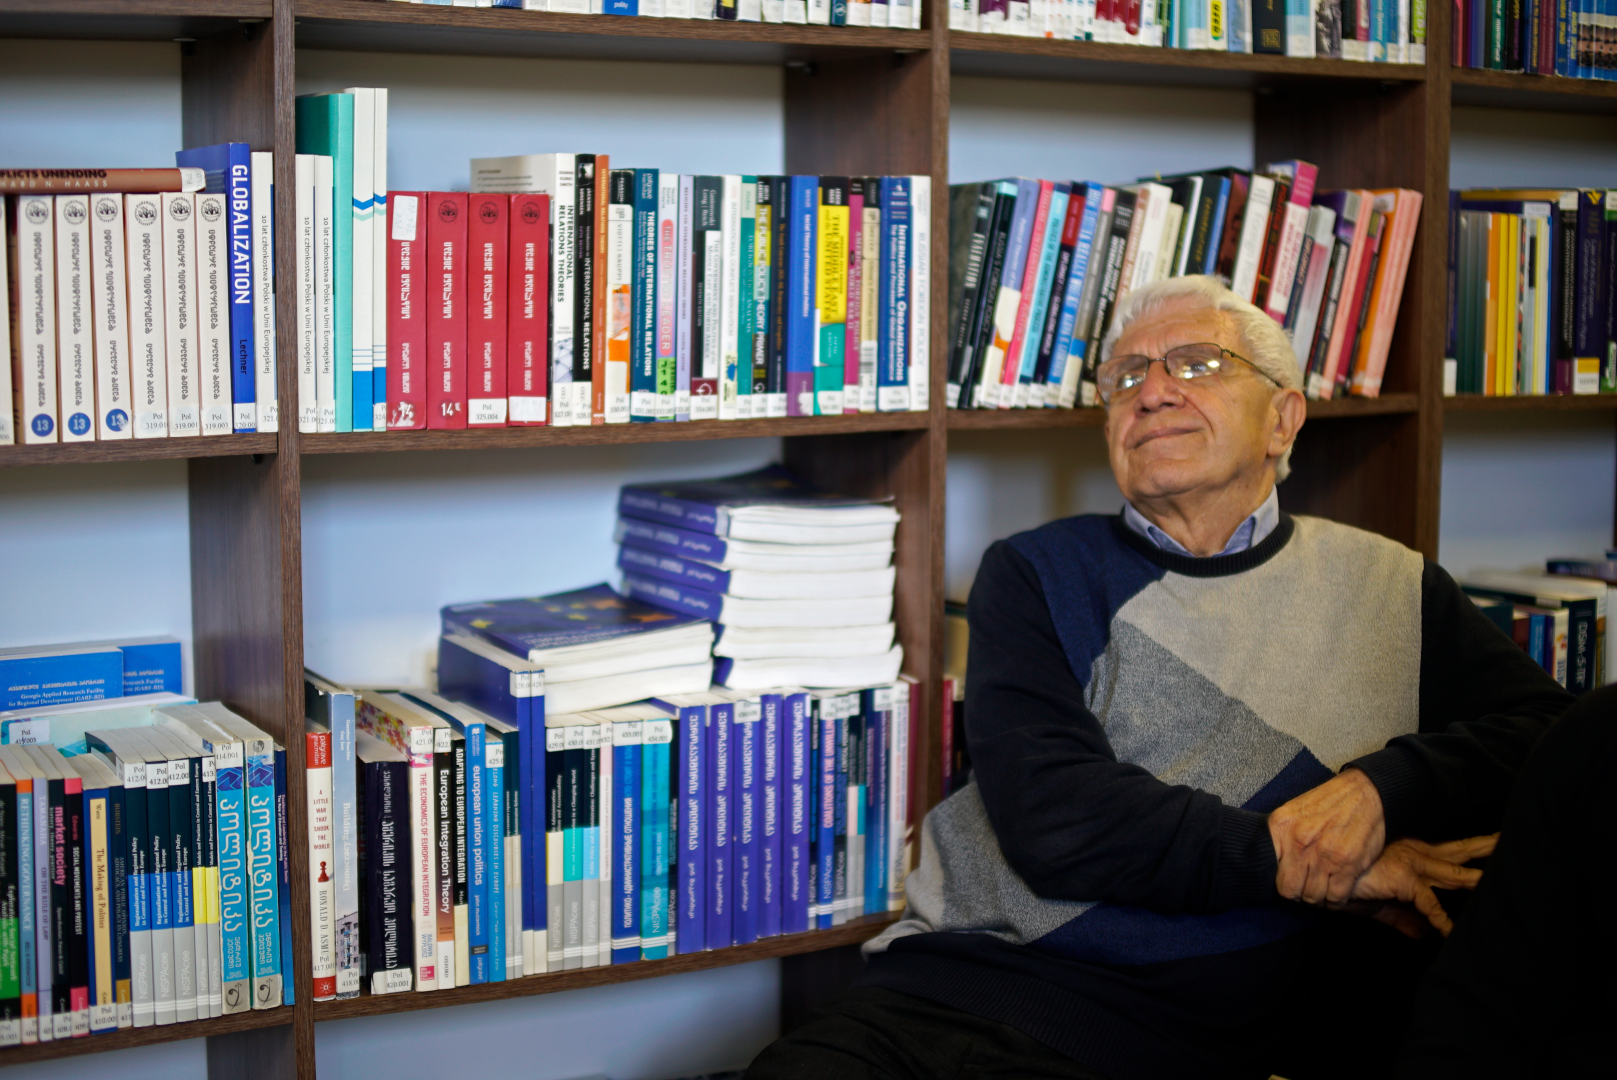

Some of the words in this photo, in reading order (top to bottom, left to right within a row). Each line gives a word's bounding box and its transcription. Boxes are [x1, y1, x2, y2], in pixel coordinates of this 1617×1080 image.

[614, 2, 628, 10] polity
[232, 164, 249, 304] GLOBALIZATION
[647, 211, 655, 250] THEORIES
[759, 208, 768, 224] THE
[832, 215, 840, 239] THE
[142, 233, 150, 272] პროექტი
[208, 229, 216, 268] პროექტი
[401, 242, 410, 270] მიწები
[443, 242, 452, 270] მიწები
[646, 252, 653, 263] OF
[758, 226, 767, 258] PUBLIC
[897, 225, 908, 297] INTERNATIONAL
[917, 232, 926, 275] RUSSIAN
[662, 244, 672, 299] TRUSTED
[757, 261, 766, 297] POLICY
[831, 240, 839, 286] MIDDLE
[1331, 244, 1348, 300] INTERNATIONAL
[144, 276, 152, 334] დემოკრატიის
[210, 271, 218, 330] დემოკრატიის
[401, 274, 410, 319] სისხლიანი
[443, 273, 452, 319] სისხლიანი
[645, 265, 653, 329] INTERNATIONAL
[756, 298, 766, 329] THEORY
[802, 296, 810, 317] Politics
[830, 289, 838, 315] EAST
[917, 279, 926, 323] FOREIGN
[662, 302, 672, 349] LEADER
[1093, 298, 1107, 338] RELATIONS
[1322, 302, 1338, 339] SECURITY
[239, 339, 247, 375] Lechner
[755, 331, 765, 364] PRIMER
[896, 301, 907, 380] ORGANIZATIONS
[917, 328, 926, 366] POLICY
[1088, 340, 1099, 370] THEORY
[36, 420, 48, 432] 13
[175, 421, 198, 430] 319.001
[205, 422, 229, 430] 319.003
[442, 403, 454, 416] 14
[456, 748, 464, 784] ADAPTING
[689, 715, 699, 794] ევროკავშირის
[717, 712, 727, 790] ევროკავშირის
[824, 758, 834, 771] THE
[440, 769, 450, 818] European
[456, 786, 464, 795] TO
[472, 766, 483, 814] european
[824, 774, 834, 783] OF
[55, 807, 65, 844] market
[343, 802, 351, 840] Building
[420, 788, 428, 826] ECONOMICS
[456, 796, 465, 834] EUROPEAN
[689, 799, 699, 850] პოლიტიკა
[717, 795, 727, 846] პოლიტიკა
[824, 785, 834, 828] COALITIONS
[20, 798, 30, 862] RETHINKING
[382, 821, 397, 866] ამერიკის
[421, 828, 428, 837] OF
[440, 820, 450, 875] Integration
[474, 817, 483, 846] union
[54, 846, 66, 885] society
[220, 798, 243, 932] პოლიტიკა
[251, 795, 274, 928] პოლიტიკა
[343, 840, 351, 891] Democracy
[422, 838, 430, 873] EUROPEAN
[457, 836, 466, 883] INTEGRATION
[473, 848, 484, 885] politics
[837, 851, 845, 894] NISPAcee
[73, 867, 81, 899] MOVEMENTS
[96, 864, 105, 891] Making
[382, 870, 396, 913] საგარეო
[440, 878, 451, 913] Theory
[809, 864, 817, 902] NISPAcee
[823, 855, 832, 899] NISPAcee
[8, 885, 16, 925] Exploratory
[22, 863, 31, 931] GOVERNANCE
[98, 903, 106, 929] Politics
[652, 887, 661, 933] NISPAcee
[668, 890, 676, 926] NISPAcee
[384, 918, 398, 968] პოლიტიკა
[553, 906, 561, 948] NISPAcee
[182, 950, 190, 996] NISPAcee
